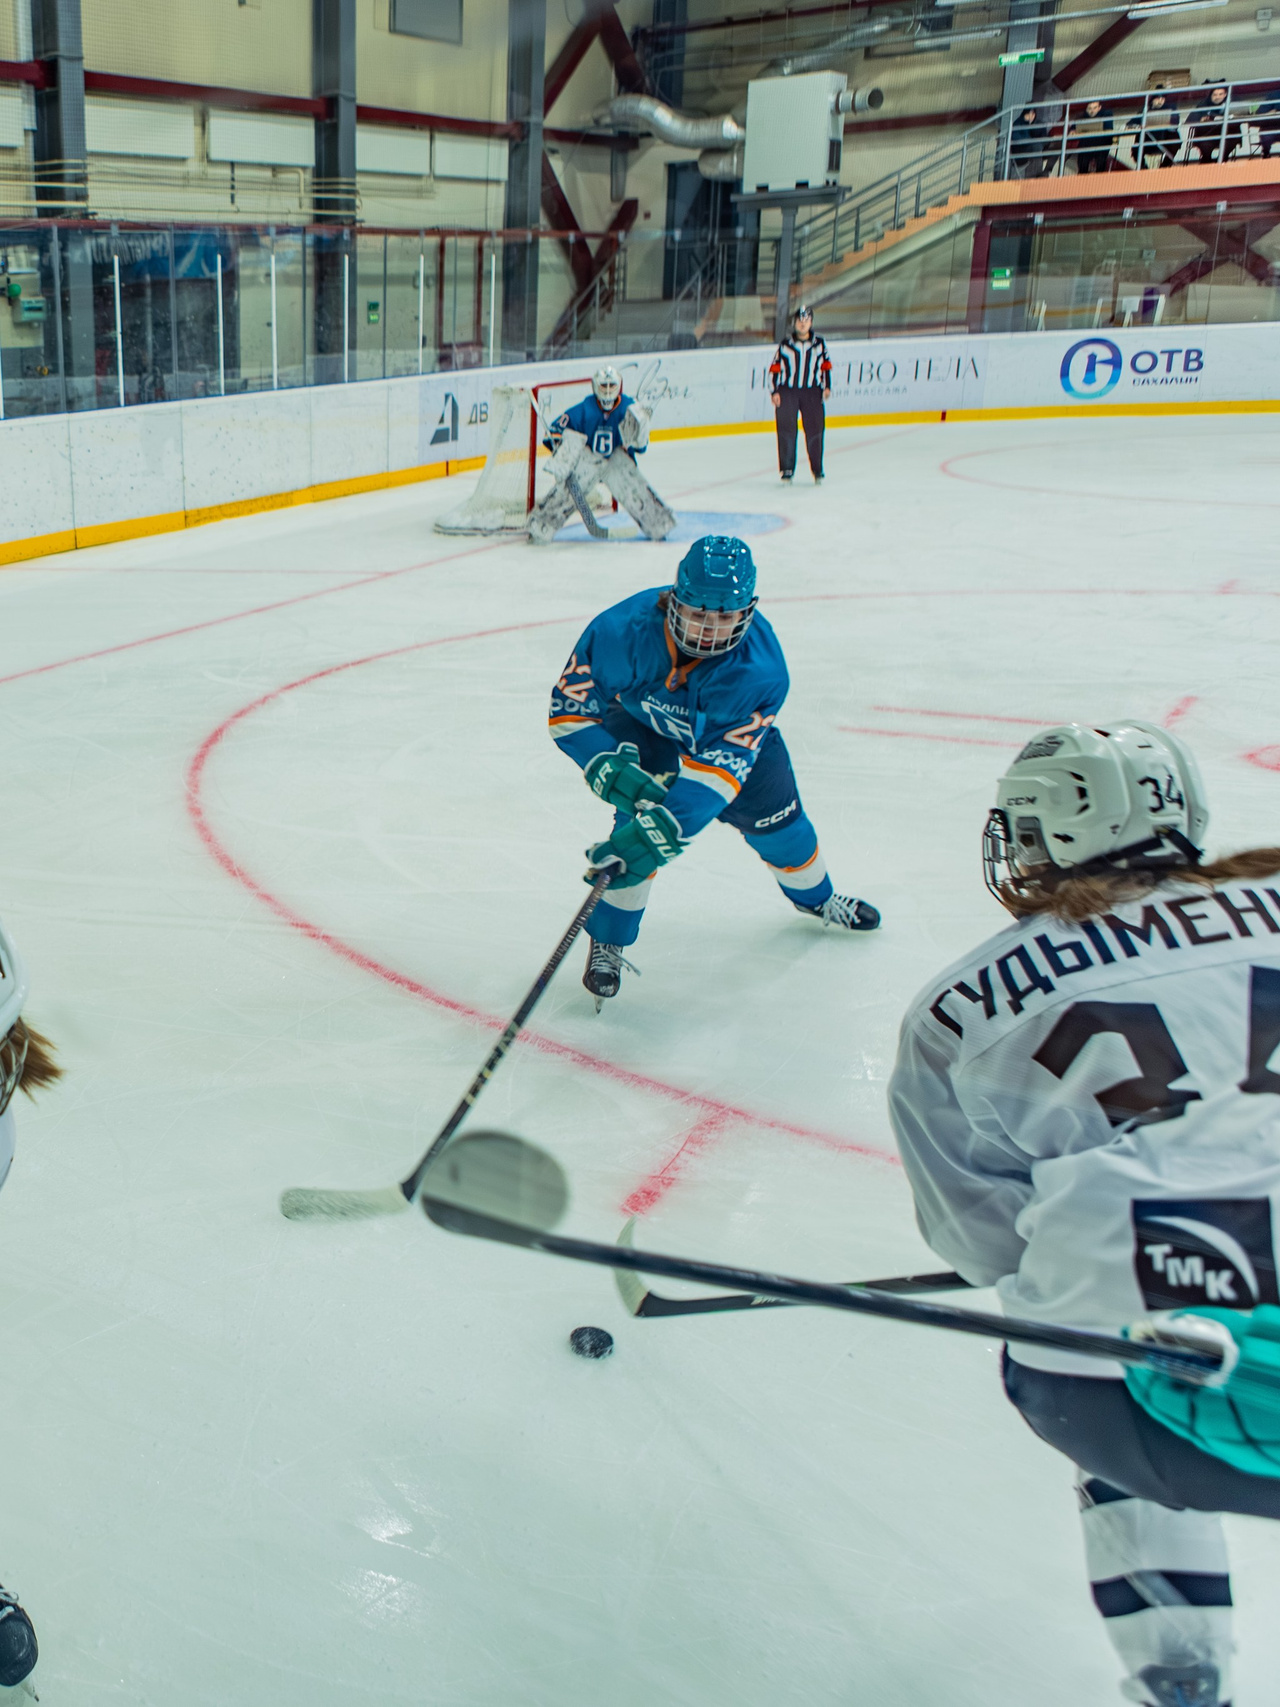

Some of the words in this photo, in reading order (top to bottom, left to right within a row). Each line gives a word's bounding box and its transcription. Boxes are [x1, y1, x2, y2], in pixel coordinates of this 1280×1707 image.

[1130, 348, 1204, 374] ОТВ
[1132, 376, 1199, 387] САХАЛИН
[1137, 774, 1184, 814] 34
[755, 800, 799, 828] CCM
